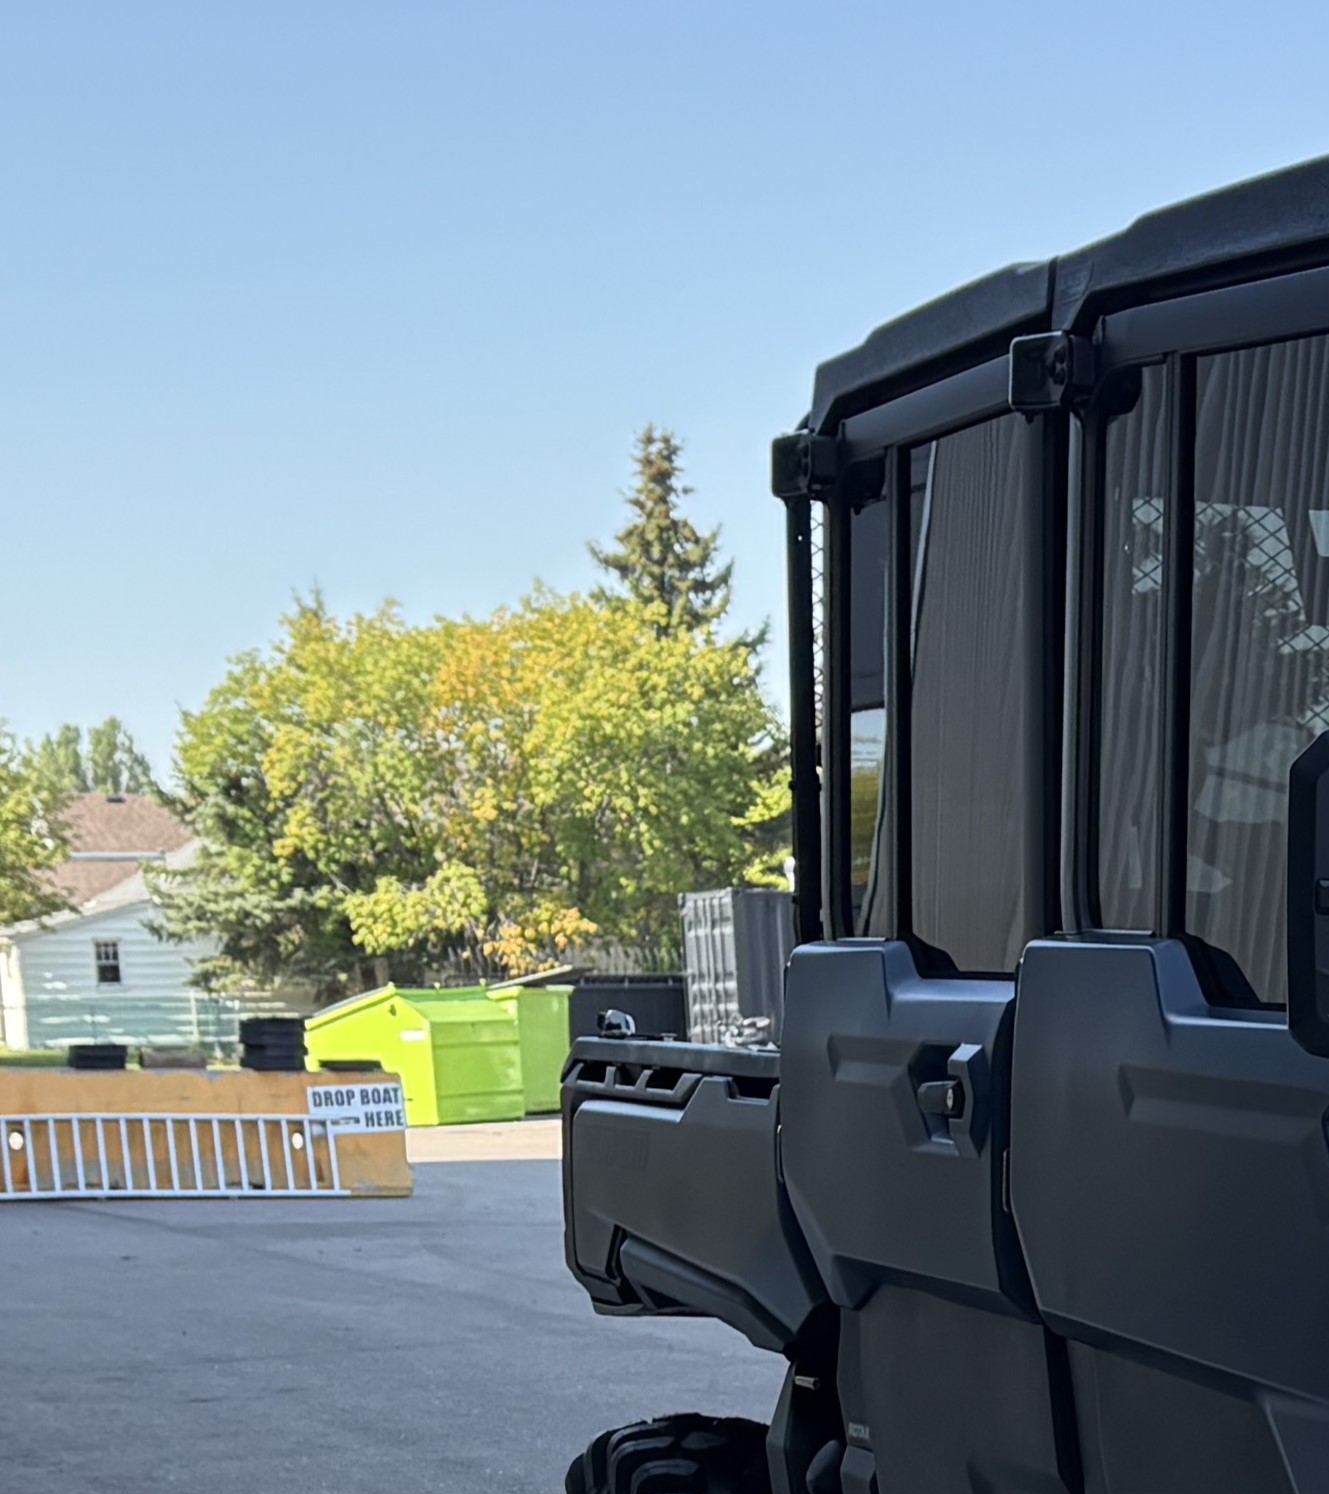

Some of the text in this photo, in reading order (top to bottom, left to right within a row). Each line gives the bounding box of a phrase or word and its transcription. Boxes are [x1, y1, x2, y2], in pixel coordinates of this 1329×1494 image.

[312, 1086, 400, 1108] DROP BOAT
[364, 1109, 404, 1128] HERE
